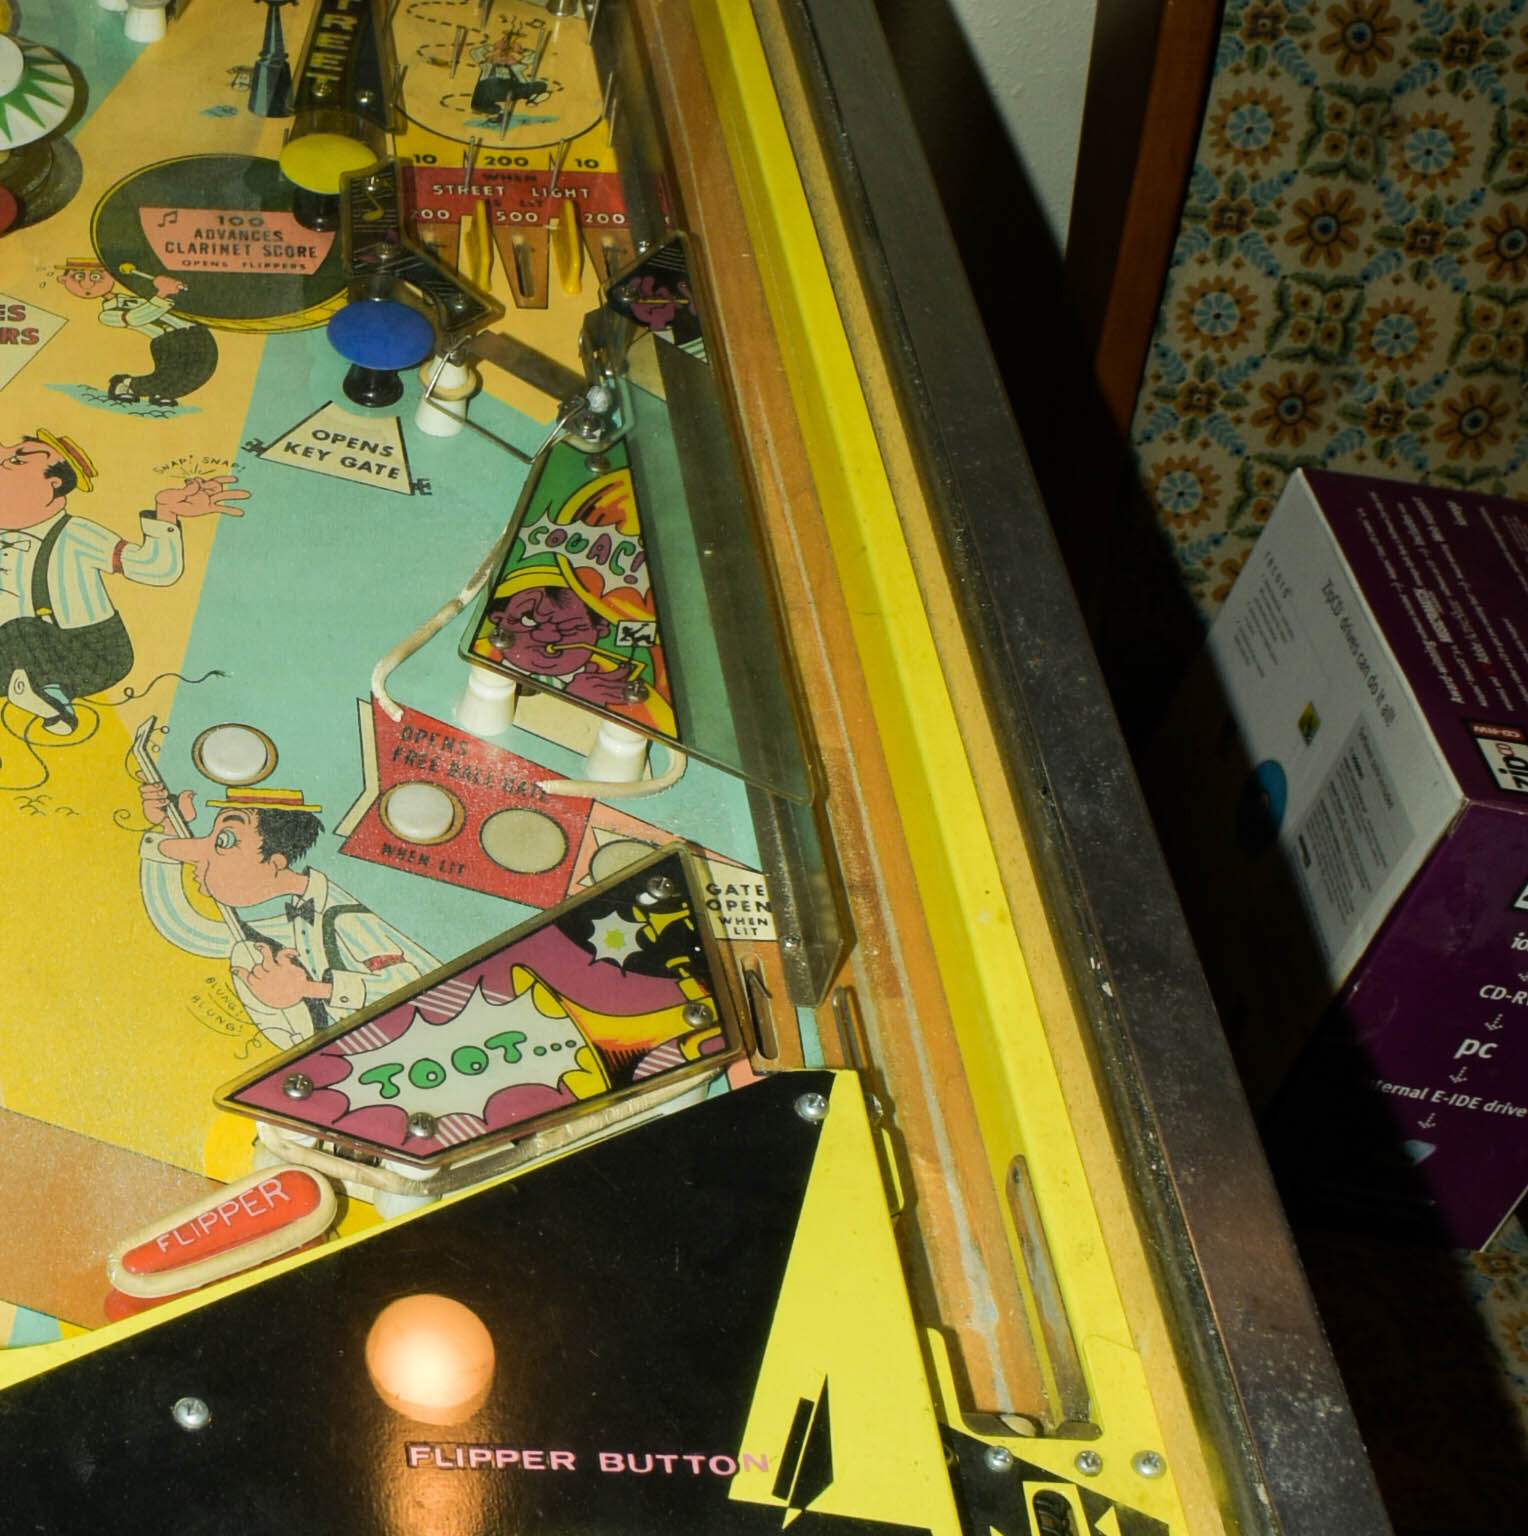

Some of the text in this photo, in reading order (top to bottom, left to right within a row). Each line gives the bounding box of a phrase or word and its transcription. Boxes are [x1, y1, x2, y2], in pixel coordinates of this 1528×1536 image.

[414, 153, 599, 169] 10 200 10
[433, 184, 591, 199] STREET LIGHT
[217, 215, 265, 227] 100
[496, 211, 626, 224] 500 200
[194, 228, 284, 242] ADVANCES
[164, 241, 319, 259] CLARINET SCORE
[312, 429, 394, 458] OPENS
[283, 441, 401, 480] KEY GATE
[528, 525, 645, 585] COUAC!
[706, 882, 764, 896] GATE
[705, 899, 772, 913] OPEN
[718, 916, 768, 926] WHEN
[734, 927, 758, 936] LIT
[1453, 1038, 1499, 1060] pc
[1430, 1089, 1482, 1110] E-IDE
[1483, 1100, 1528, 1118] drive
[156, 1176, 294, 1258] FLIPPER
[408, 1445, 770, 1476] FLIPPER BUTTON
